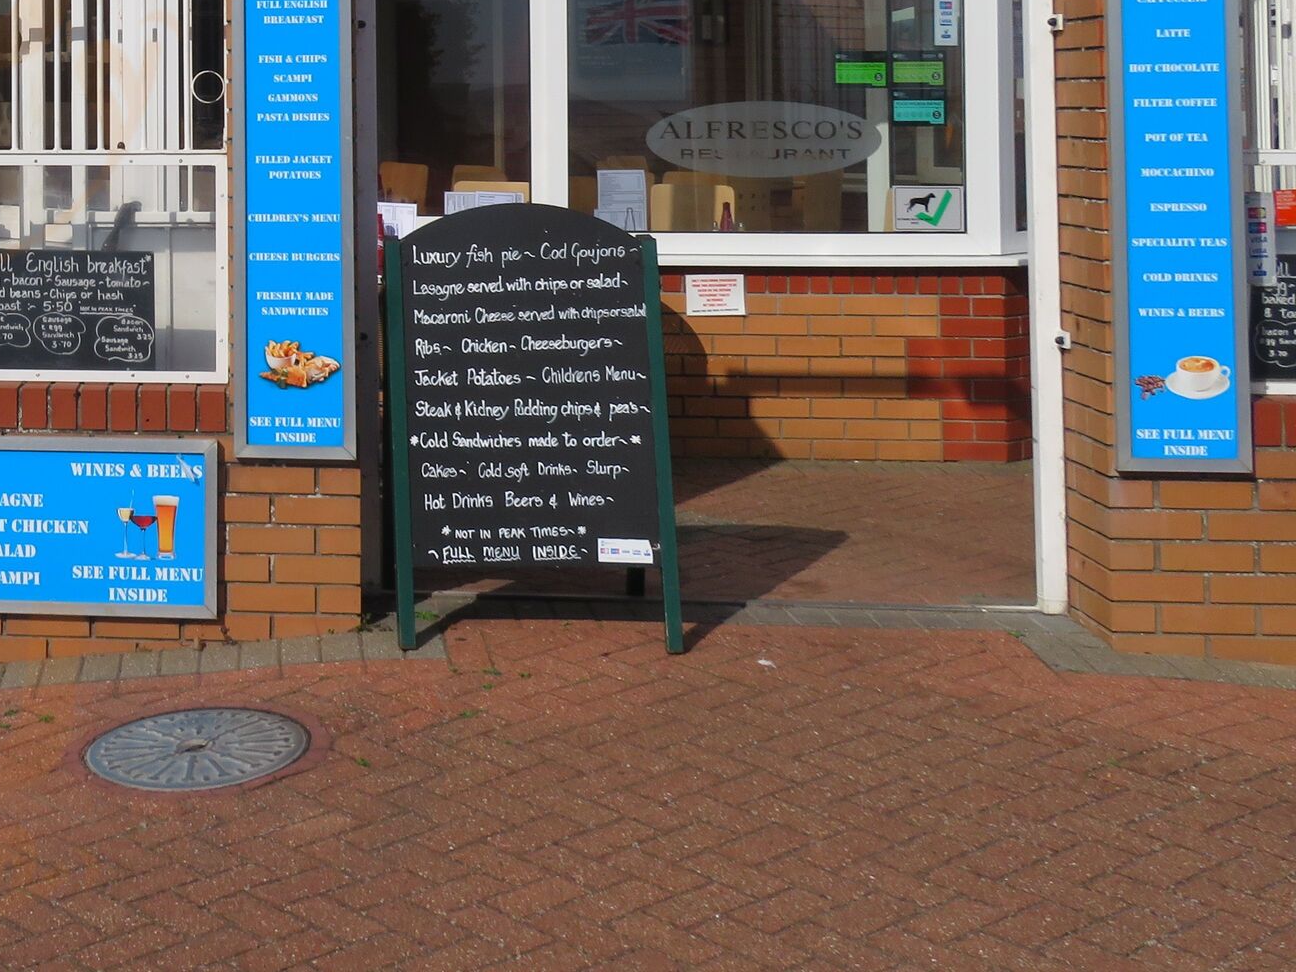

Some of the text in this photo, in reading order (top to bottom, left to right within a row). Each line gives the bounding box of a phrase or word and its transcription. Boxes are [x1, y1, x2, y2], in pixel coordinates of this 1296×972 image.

[284, 0, 327, 8] ENGLISH
[264, 16, 323, 24] BREAKFAST
[1157, 29, 1190, 37] LATTE
[259, 55, 282, 63] FISH
[1130, 64, 1219, 72] HOT CHOCOLATE
[1134, 98, 1216, 107] FILTER COFFEE
[292, 113, 329, 121] DISHES
[659, 120, 864, 140] ALFRESCO'S
[1186, 133, 1207, 141] TEA
[680, 148, 851, 161] REURANT
[270, 171, 321, 179] POTATOES
[1142, 168, 1214, 176] MOCCACHINO
[1151, 203, 1207, 211] ESPRESSO
[248, 214, 340, 222] CHILDREN'S MENU
[1132, 238, 1227, 246] SPECIALITY TEAS
[292, 253, 340, 261] BURGERS
[413, 243, 625, 268] Luxury fish pie Cod Goujons
[25, 252, 79, 279] English
[88, 255, 148, 279] breakfast
[12, 271, 42, 286] bacon
[105, 275, 141, 287] tomato
[1143, 273, 1218, 281] COLD DRINKS
[413, 272, 620, 301] Lasagne served with chips or salad
[257, 292, 333, 300] FRESHLY MADE
[262, 307, 328, 315] SANDWICHES
[414, 305, 580, 324] Macaroni Cheese served with
[1139, 308, 1174, 316] WINES
[1189, 309, 1224, 317] BEERS
[462, 338, 507, 353] Chicken
[521, 334, 612, 356] Cheeseburgers
[415, 366, 635, 386] Jacket Potatoes Childrens Menu
[415, 401, 452, 417] Steak
[455, 403, 461, 420] &
[465, 400, 509, 420] Kidney
[515, 399, 557, 423] Pudding
[561, 401, 593, 421] chips
[420, 431, 617, 448] Cold Sandwiches made to order
[71, 463, 125, 476] WINES
[130, 464, 141, 477] &
[422, 460, 623, 482] Cakes Cold soft Drinks Slurp
[425, 491, 604, 510] Hot Drinks Beers & Wines
[12, 519, 88, 533] CHICKEN
[455, 530, 475, 539] NOT
[480, 529, 491, 539] IN
[499, 528, 526, 538] PEAK
[443, 545, 581, 561] FULL MENU INSIDE
[73, 566, 203, 581] SEE FULL MENU
[107, 588, 167, 604] INSIDE
